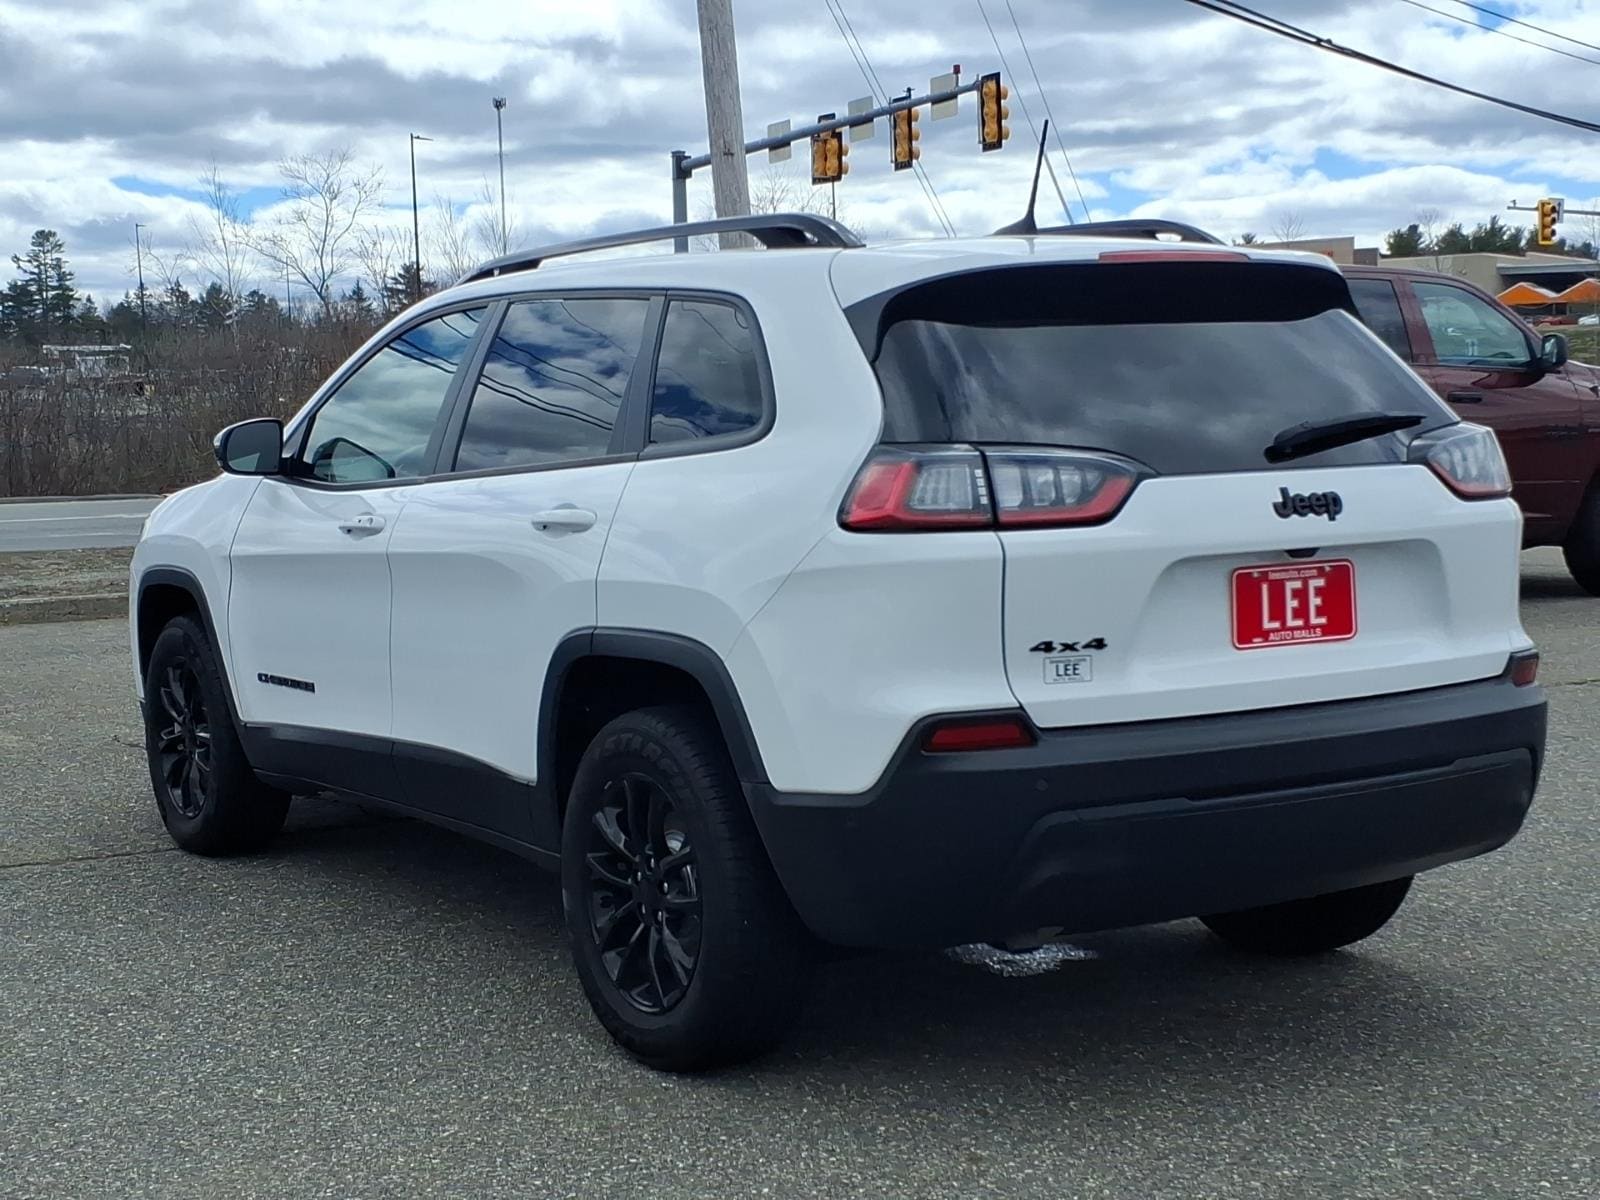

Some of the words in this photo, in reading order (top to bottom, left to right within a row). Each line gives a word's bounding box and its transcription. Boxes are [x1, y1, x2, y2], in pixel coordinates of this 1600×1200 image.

[1272, 487, 1343, 521] Jeep
[1261, 578, 1327, 630] LEE
[1268, 631, 1292, 641] AUTO
[1293, 628, 1322, 639] MALLS
[1029, 637, 1108, 653] 4x4
[1055, 663, 1080, 677] LEE
